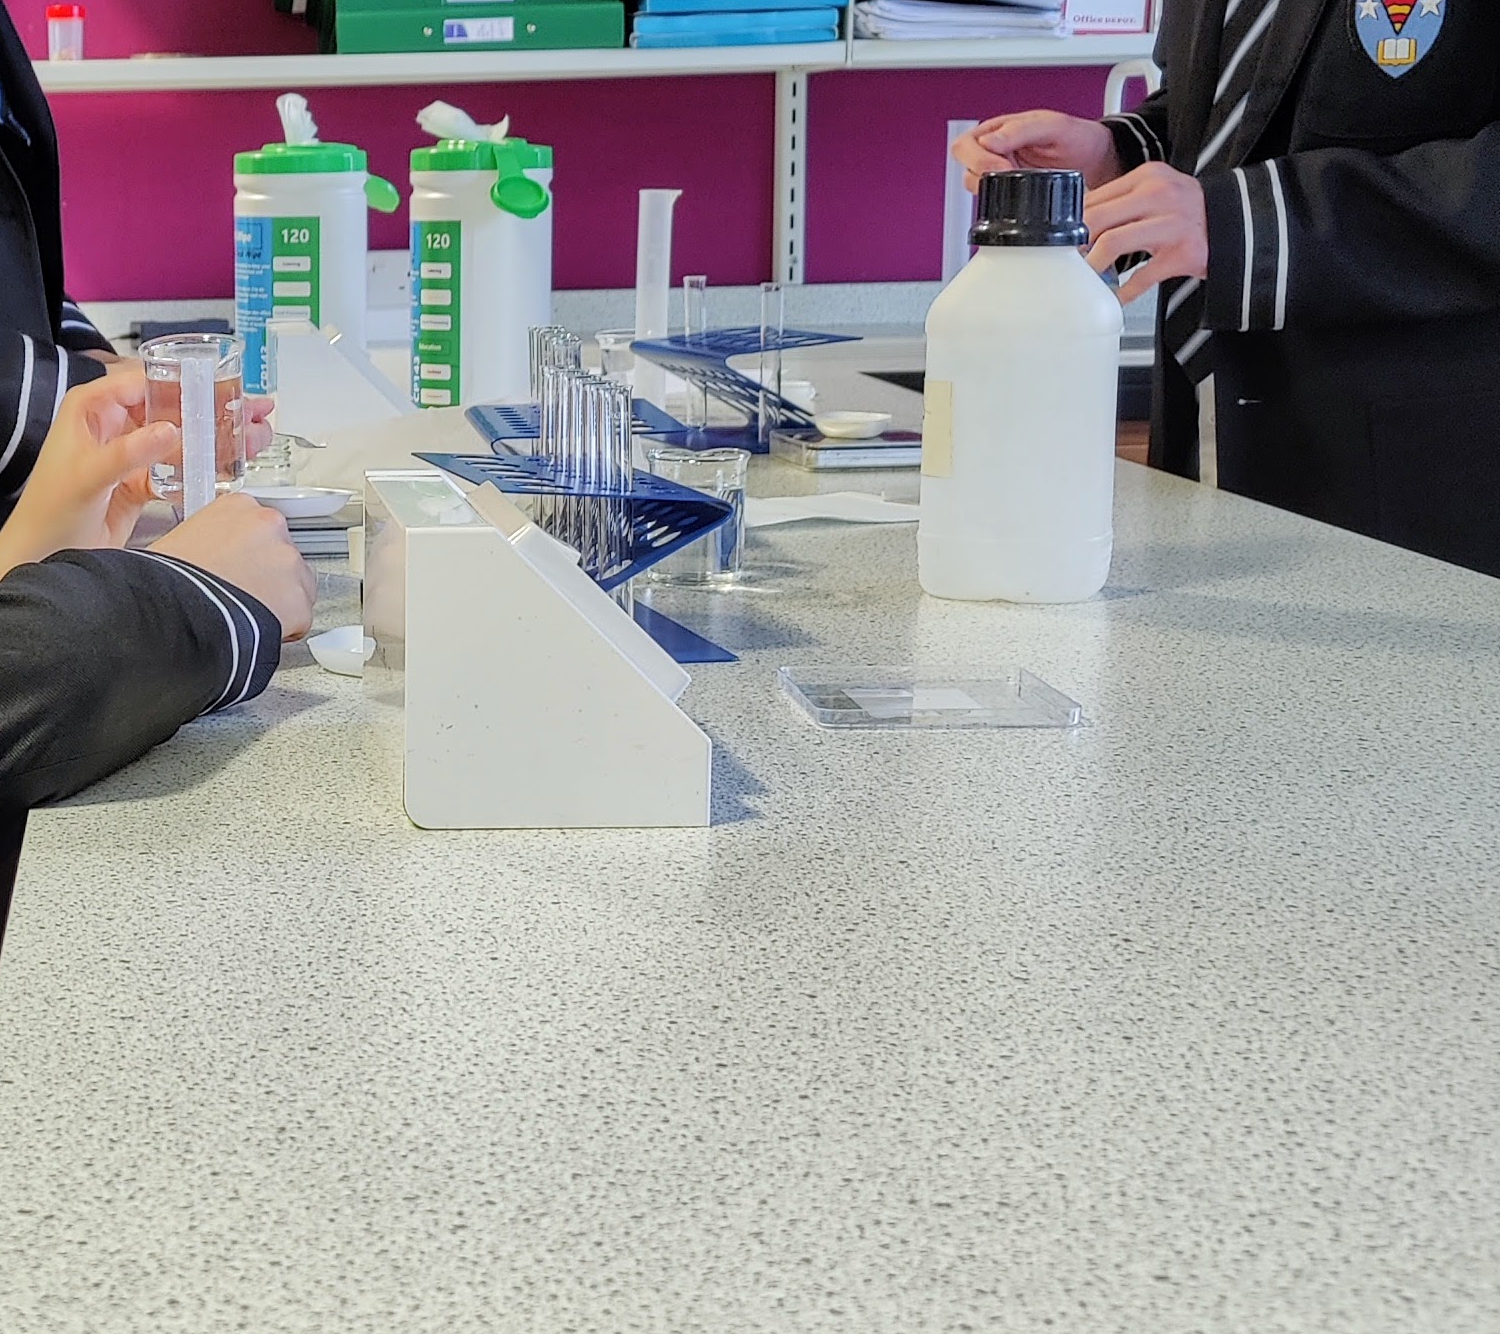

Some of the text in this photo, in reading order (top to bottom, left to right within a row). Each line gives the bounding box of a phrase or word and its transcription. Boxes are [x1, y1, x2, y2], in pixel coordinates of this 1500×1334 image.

[1073, 14, 1103, 23] Office
[281, 228, 310, 244] 120
[426, 233, 450, 249] 120
